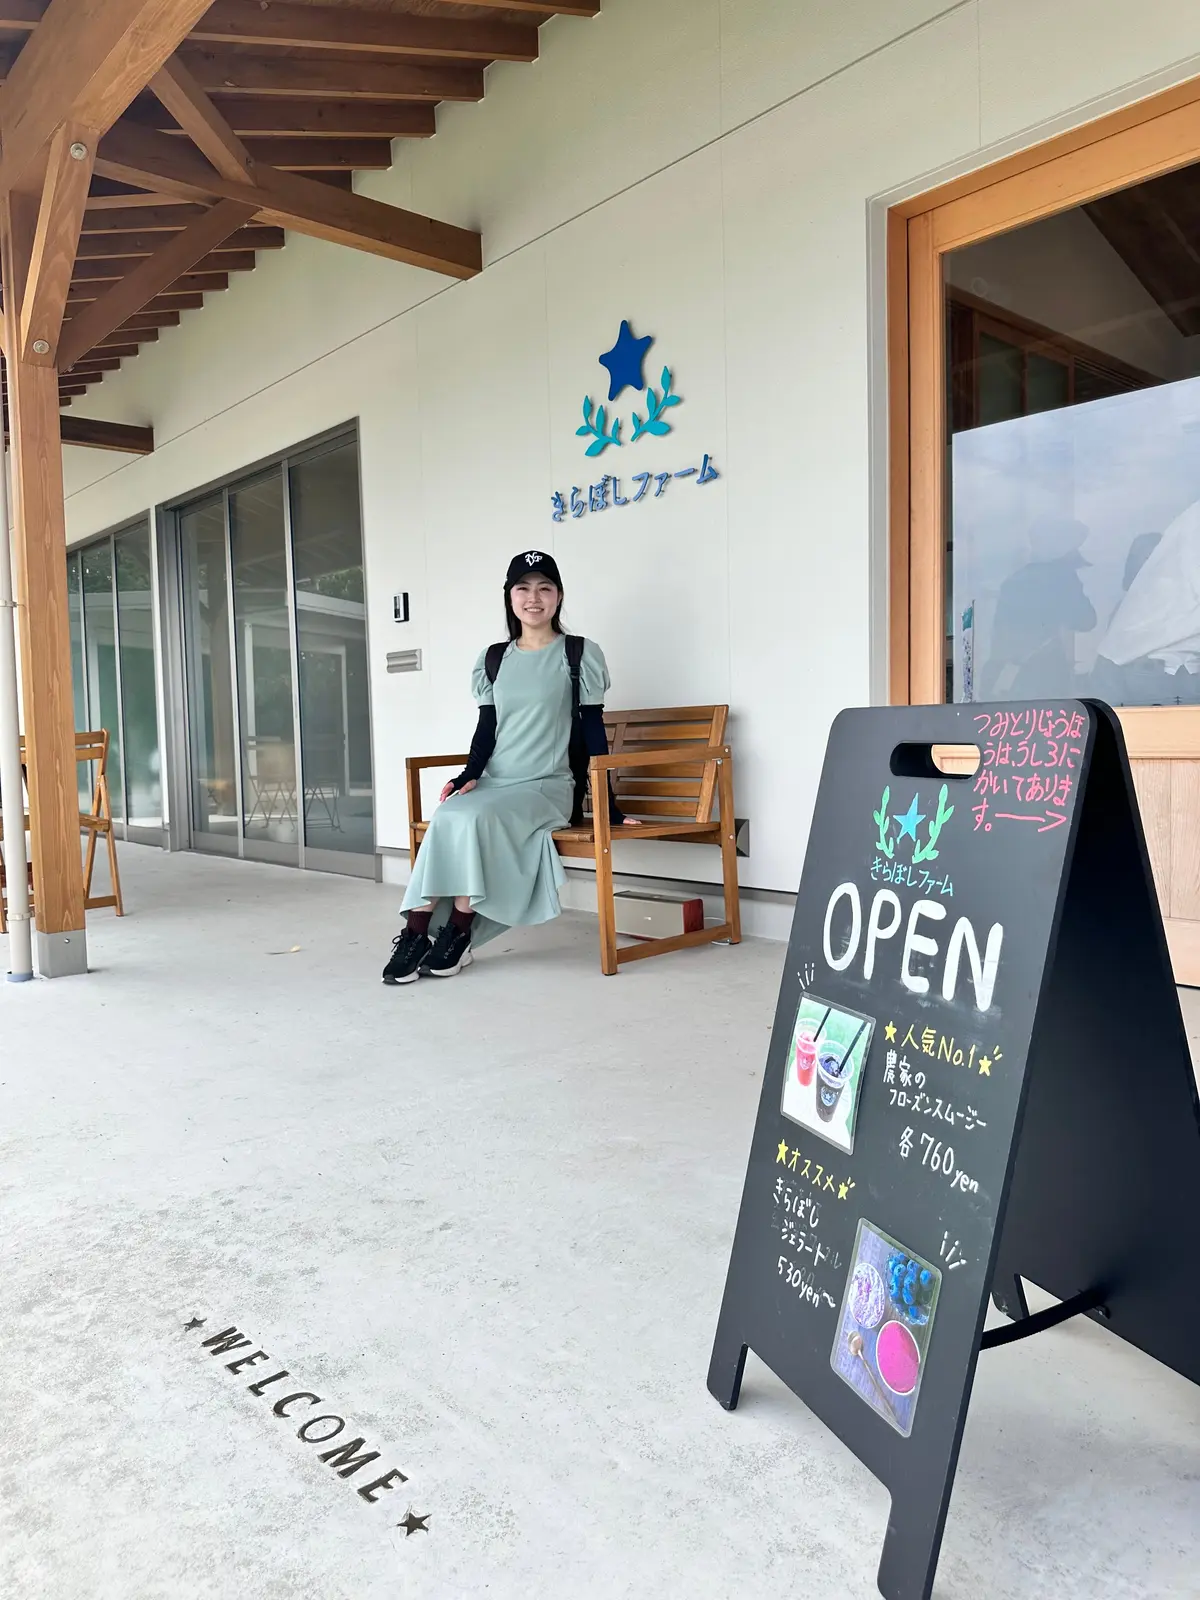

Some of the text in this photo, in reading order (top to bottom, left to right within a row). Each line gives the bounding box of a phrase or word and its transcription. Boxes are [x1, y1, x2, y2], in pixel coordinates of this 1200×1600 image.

[551, 453, 719, 522] きらぼしファーム
[973, 770, 1072, 806] かいてありま
[870, 856, 953, 897] きらぼしファーム
[823, 881, 1004, 1012] OPEN
[883, 1049, 926, 1089] 農家の
[889, 1089, 987, 1130] フローズンスムージー
[788, 1148, 835, 1192] オススメ
[201, 1326, 409, 1504] WELCOME
